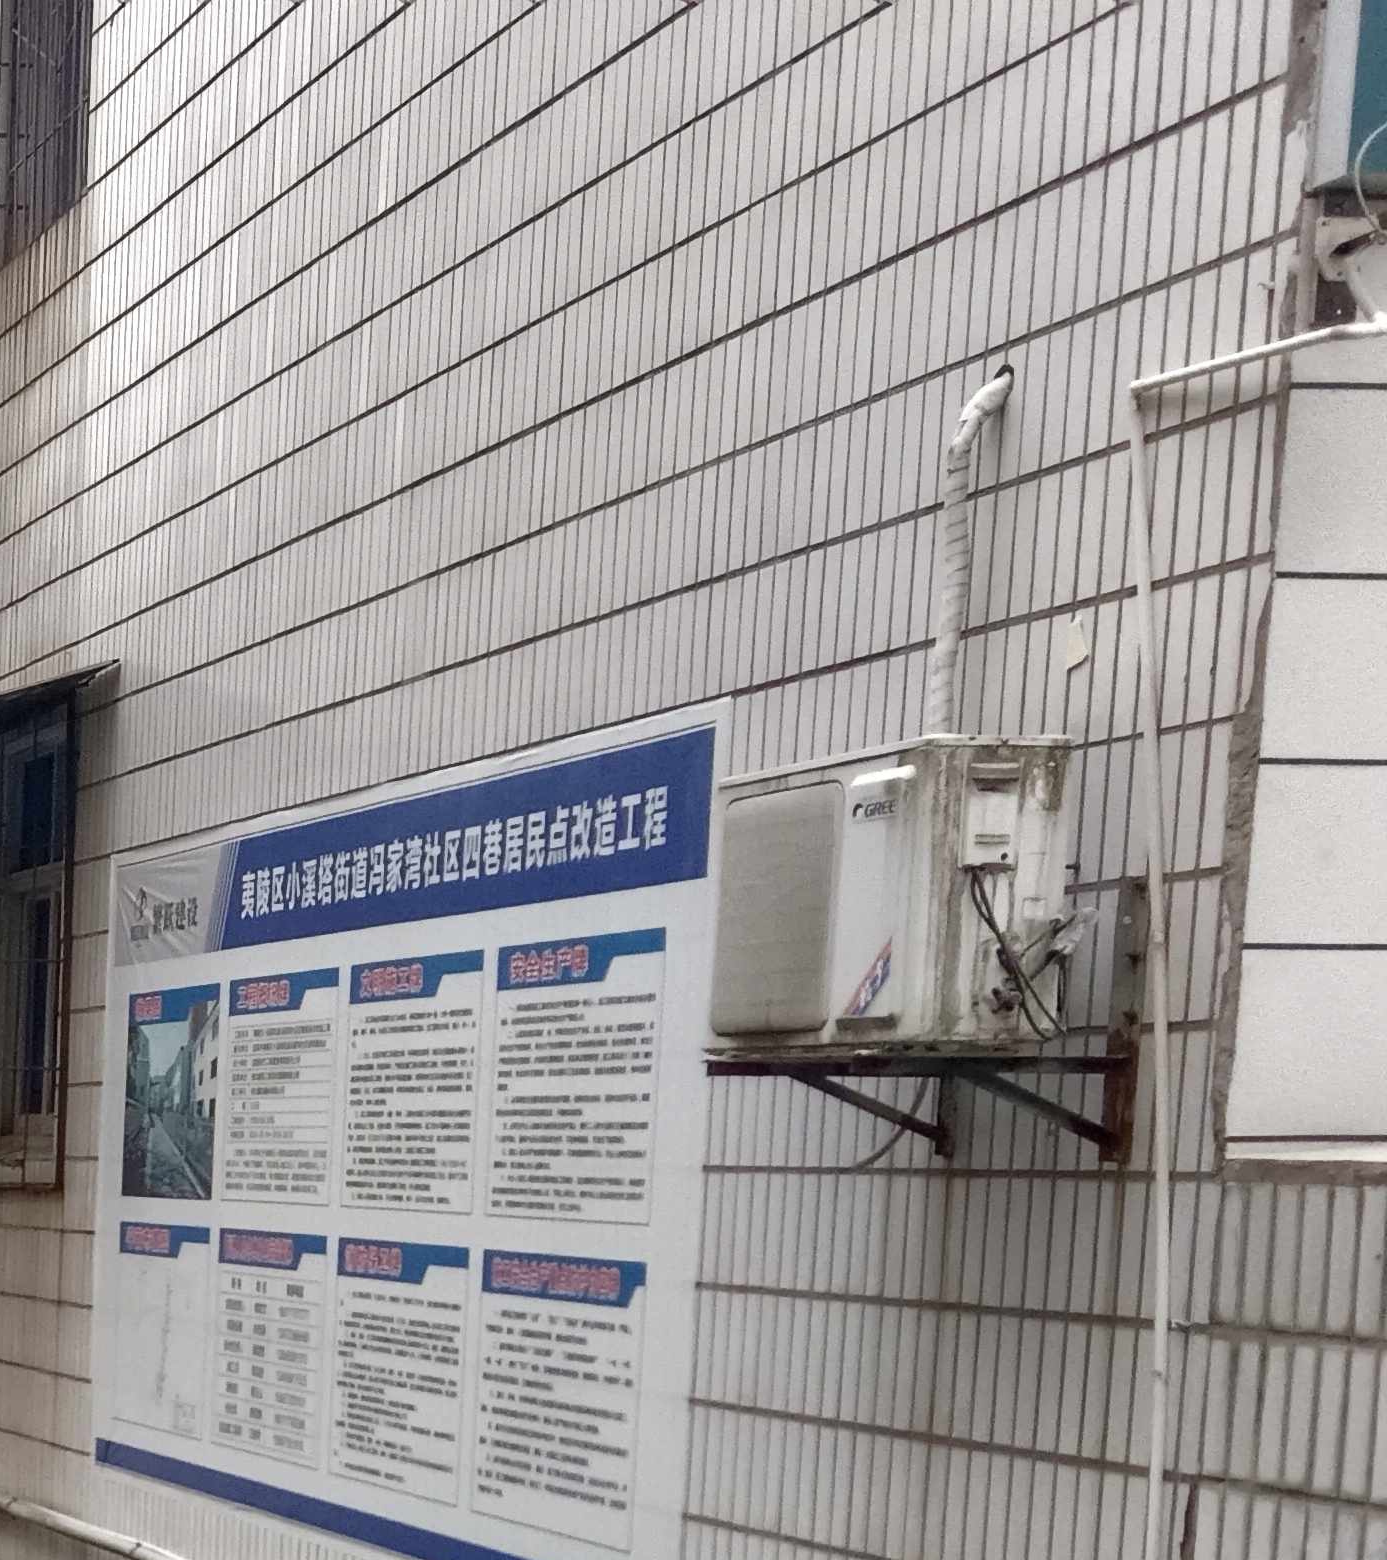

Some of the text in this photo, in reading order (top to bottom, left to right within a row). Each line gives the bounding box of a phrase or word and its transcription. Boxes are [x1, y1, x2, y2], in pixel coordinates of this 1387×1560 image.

[864, 799, 898, 818] GREE
[240, 787, 668, 920] 夷陵区小溪塔街道冯家湾社区四巷居民点改造工程
